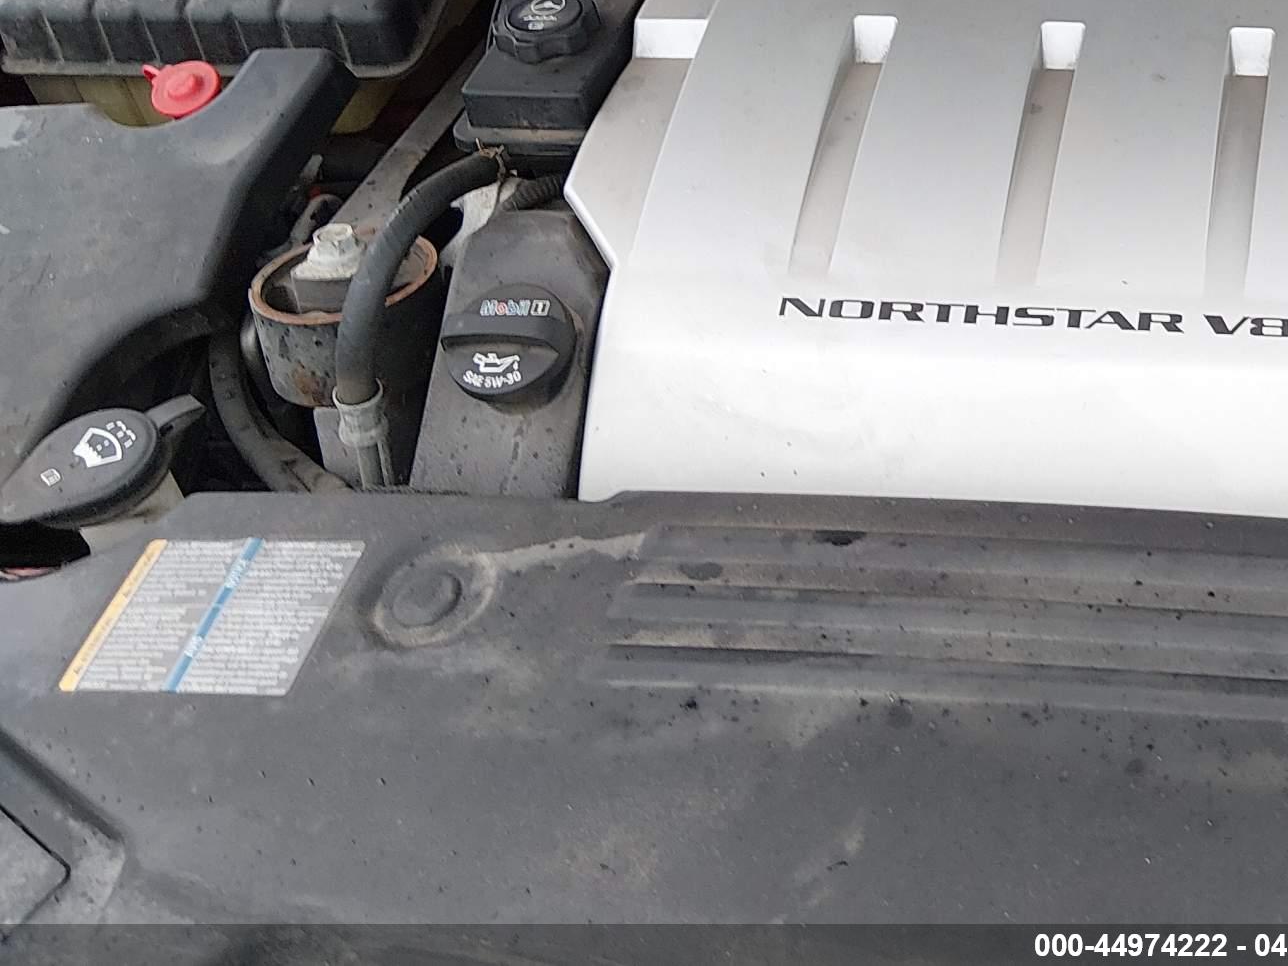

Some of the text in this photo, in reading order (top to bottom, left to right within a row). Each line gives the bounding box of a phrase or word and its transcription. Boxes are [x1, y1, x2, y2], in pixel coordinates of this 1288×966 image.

[479, 299, 531, 316] Mobil
[779, 297, 1183, 333] NORTHSTAR
[463, 370, 522, 389] SAE 5W-30
